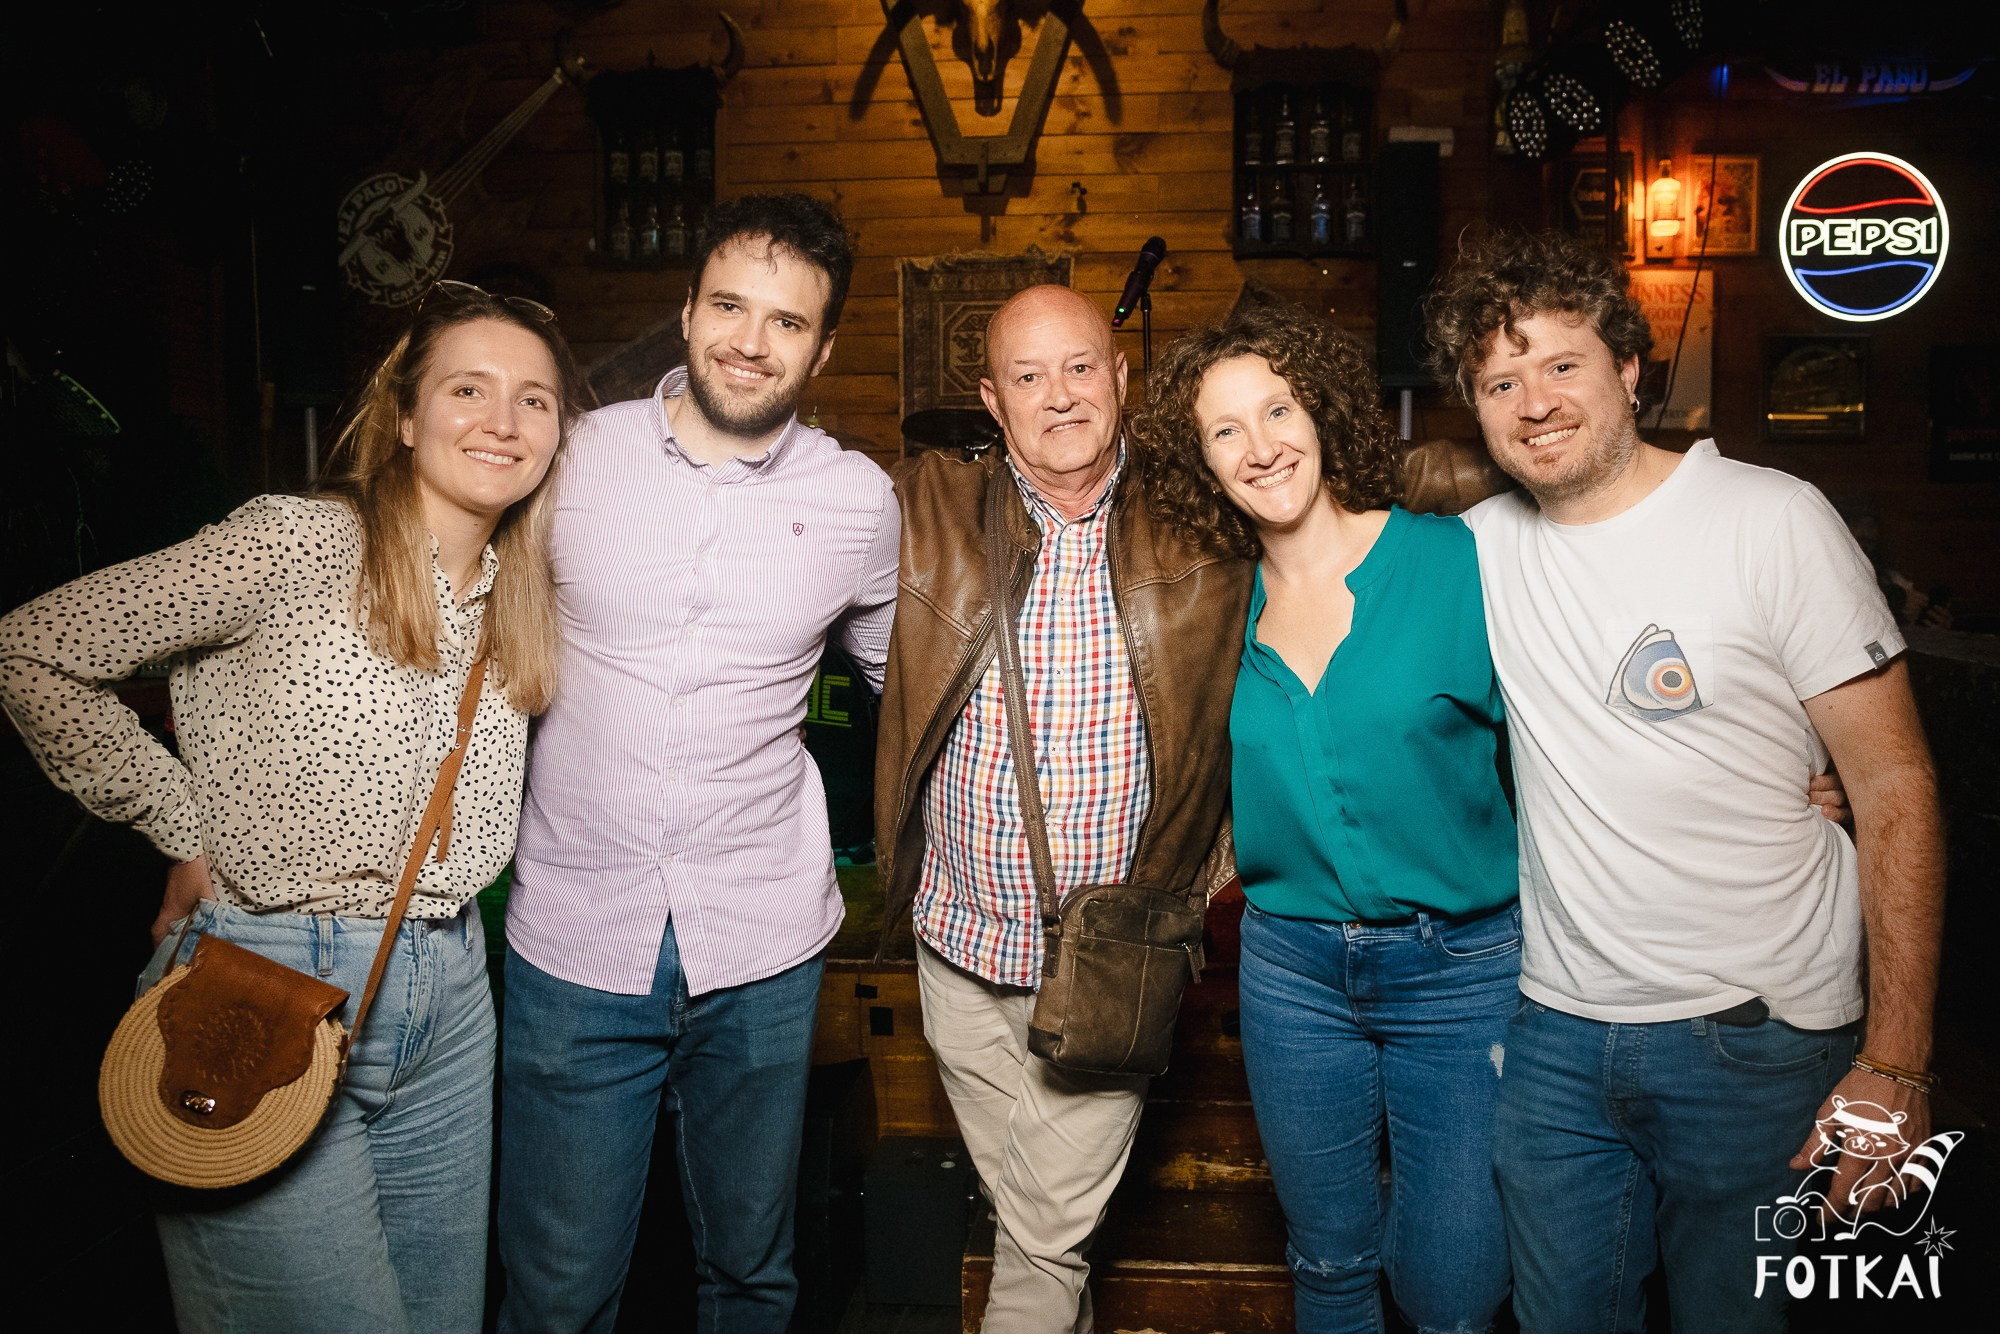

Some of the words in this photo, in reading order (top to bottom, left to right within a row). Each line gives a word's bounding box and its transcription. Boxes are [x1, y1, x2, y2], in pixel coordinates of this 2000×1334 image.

[1812, 64, 1848, 94] EL
[338, 209, 357, 236] EL
[351, 178, 398, 210] PASO
[1791, 217, 1938, 256] PEPSI
